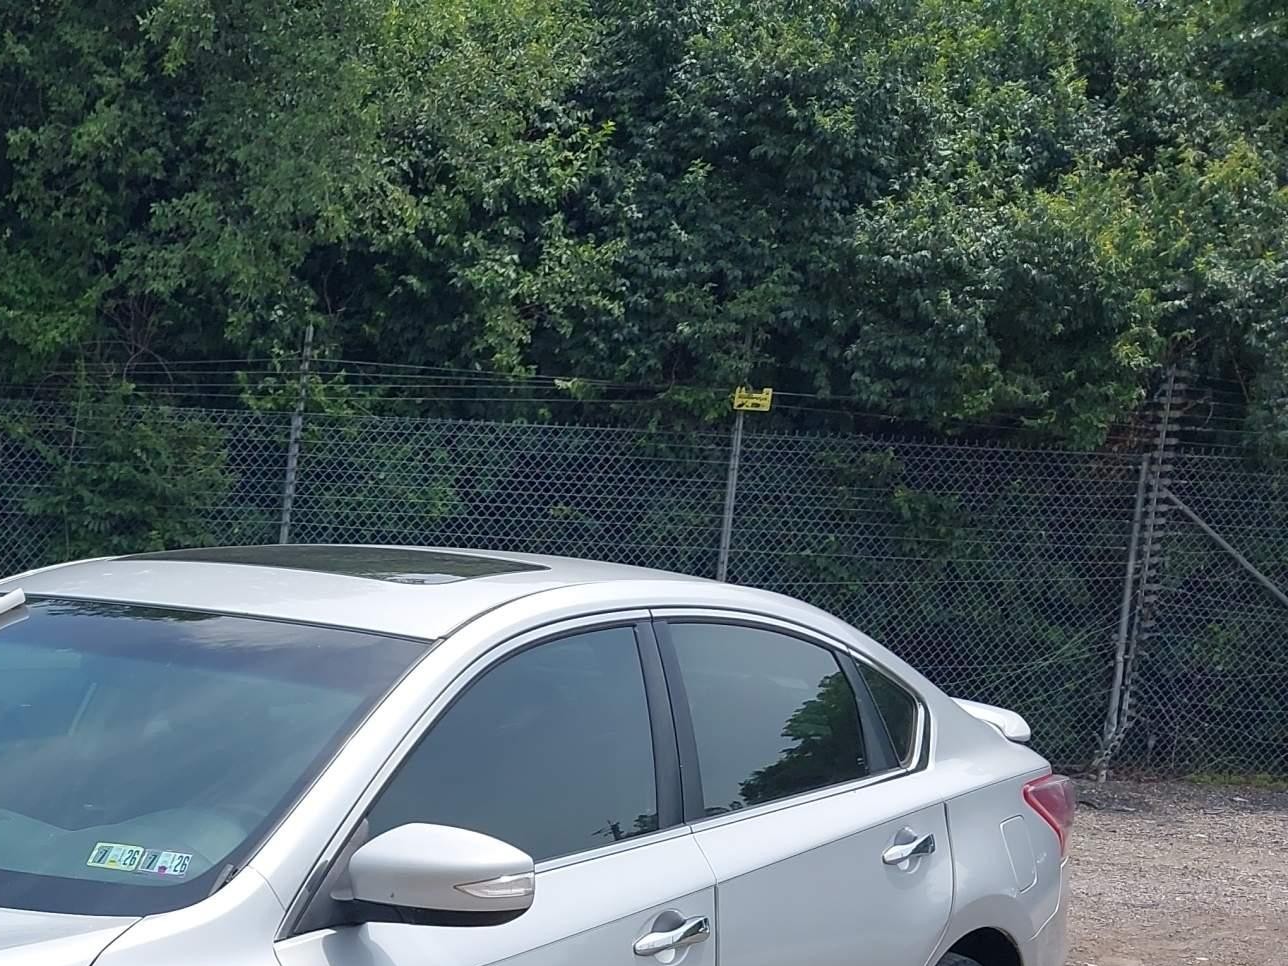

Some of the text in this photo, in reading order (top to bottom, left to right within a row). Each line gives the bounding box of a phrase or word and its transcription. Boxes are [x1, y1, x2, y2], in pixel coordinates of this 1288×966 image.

[123, 849, 140, 866] 26
[146, 854, 190, 872] 7 26
